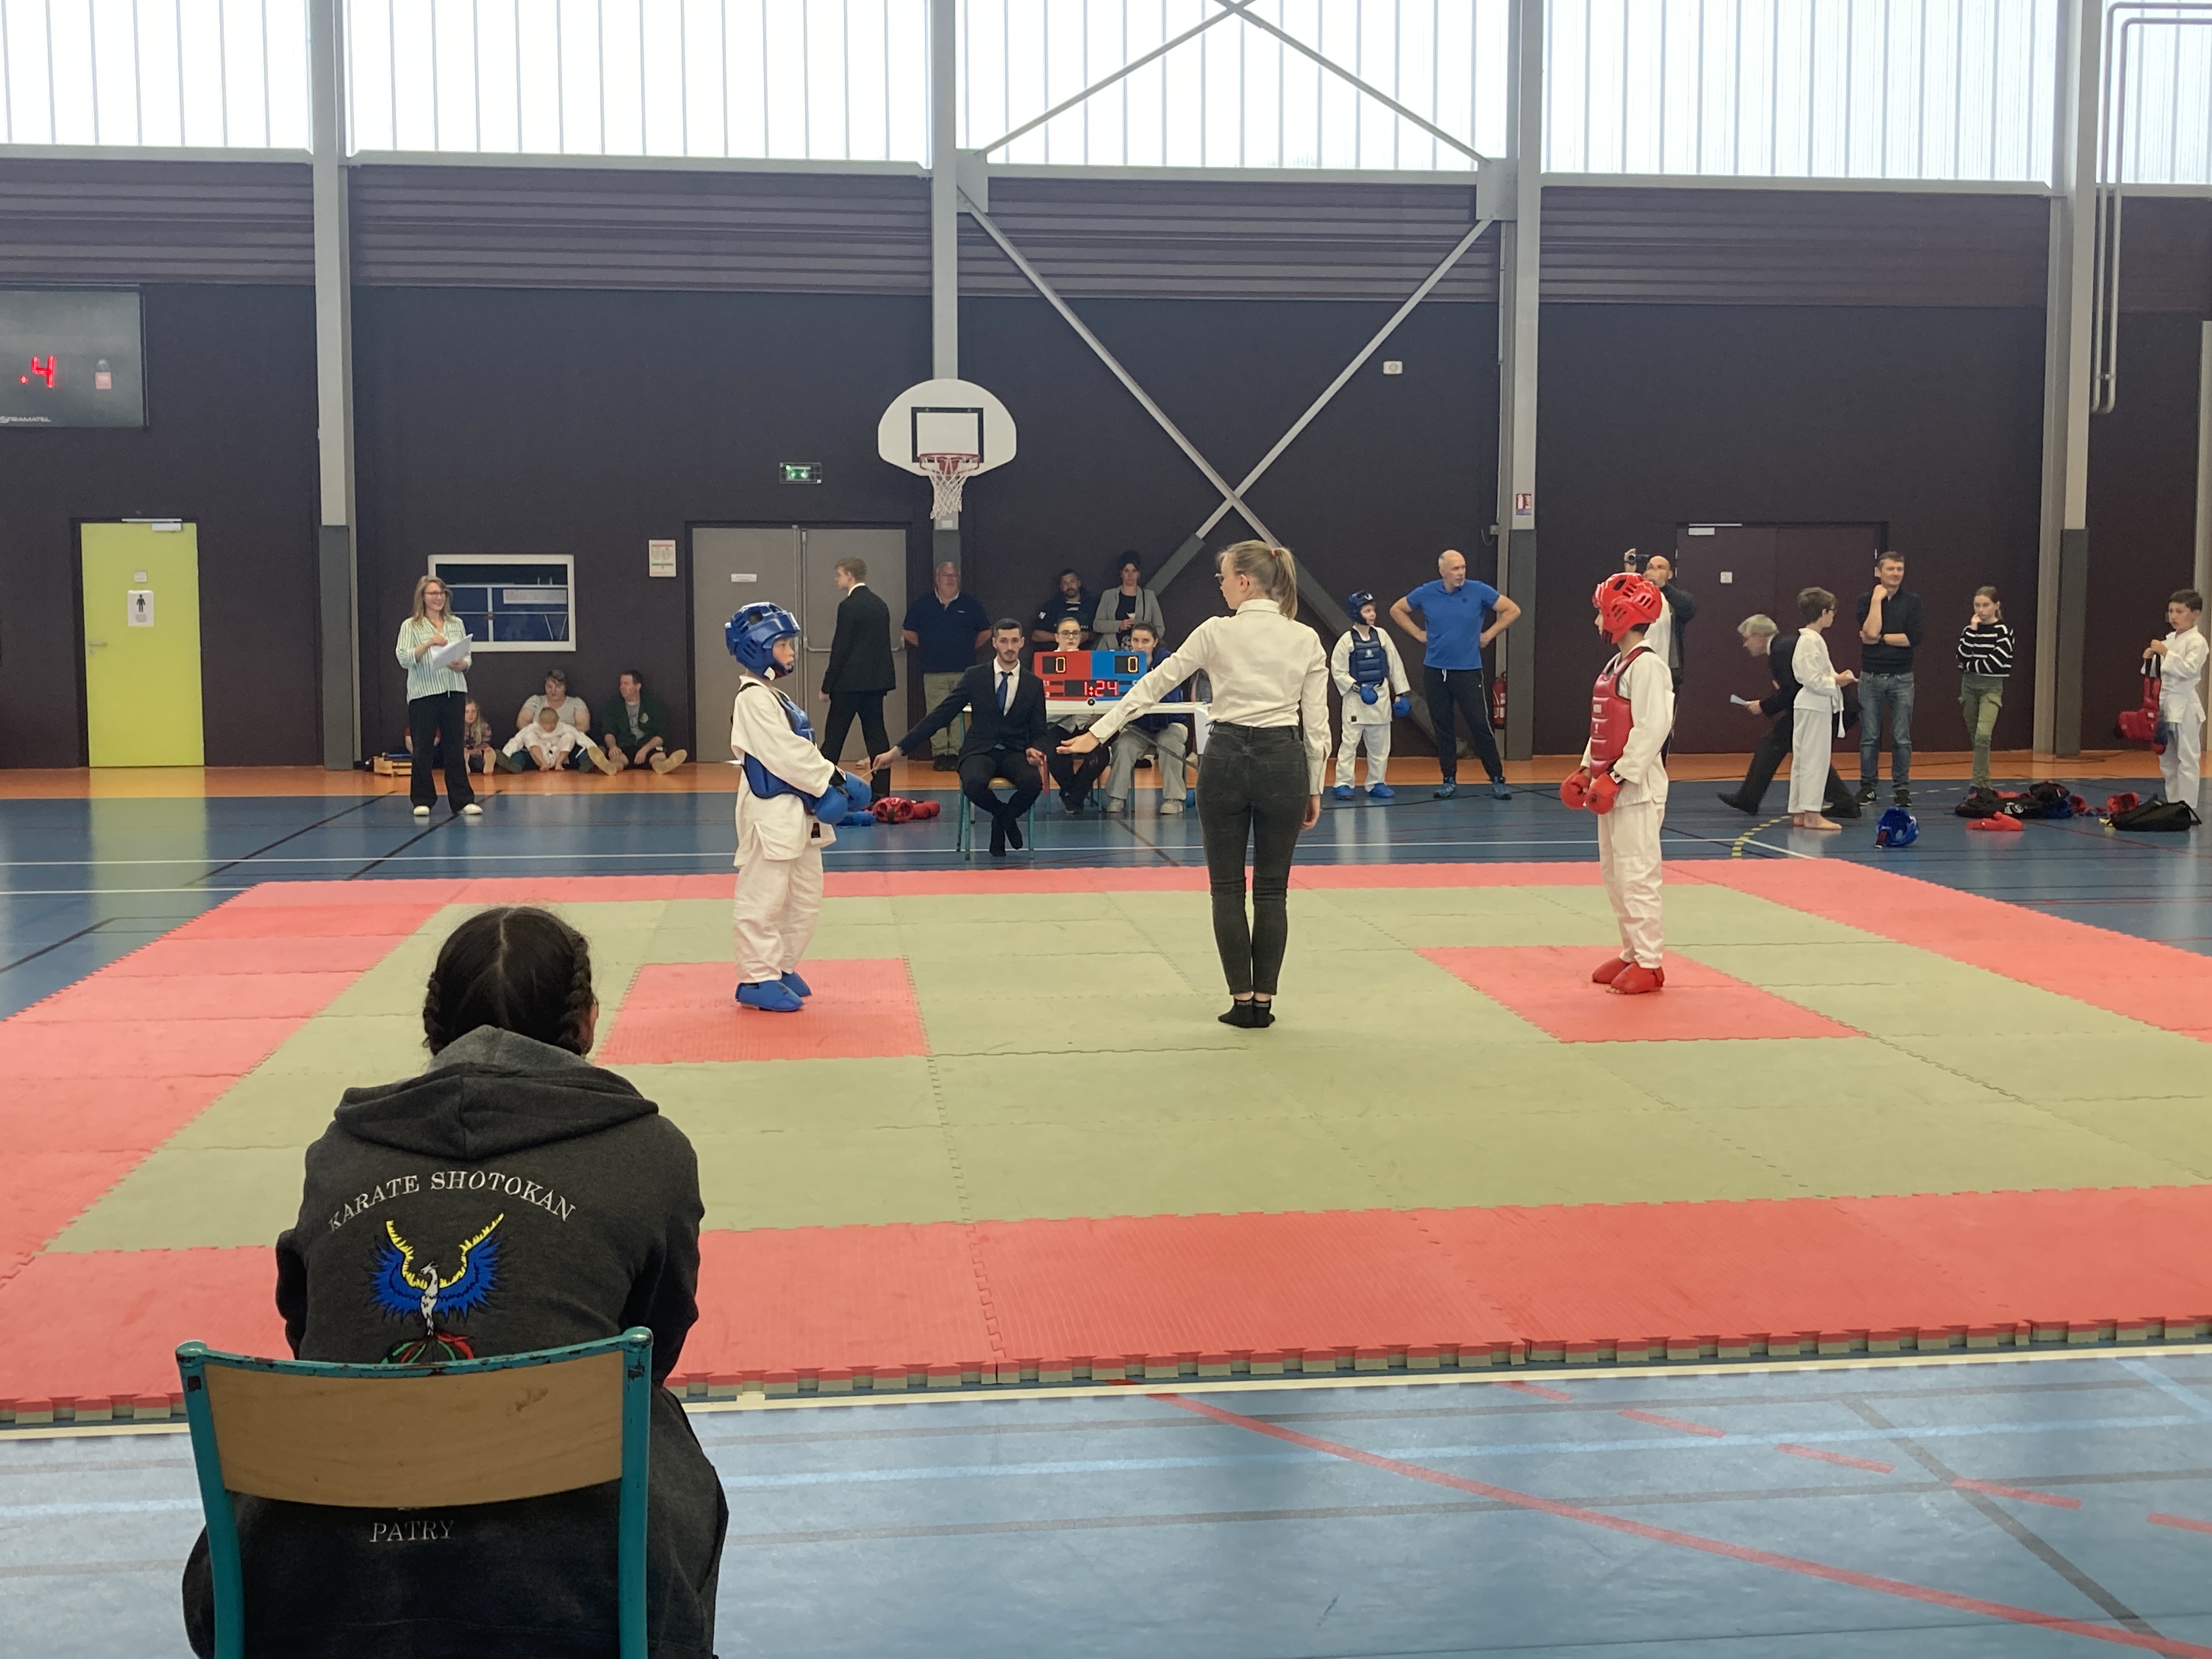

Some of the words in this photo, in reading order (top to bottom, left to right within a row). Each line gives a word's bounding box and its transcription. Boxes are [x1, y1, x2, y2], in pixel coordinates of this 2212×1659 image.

[1056, 657, 1066, 673] 0
[1127, 656, 1138, 673] 0
[1084, 680, 1119, 696] 1:24
[328, 1175, 420, 1232] KARATE
[430, 1170, 576, 1222] SHOTOKAN
[369, 1520, 454, 1542] PATRY
